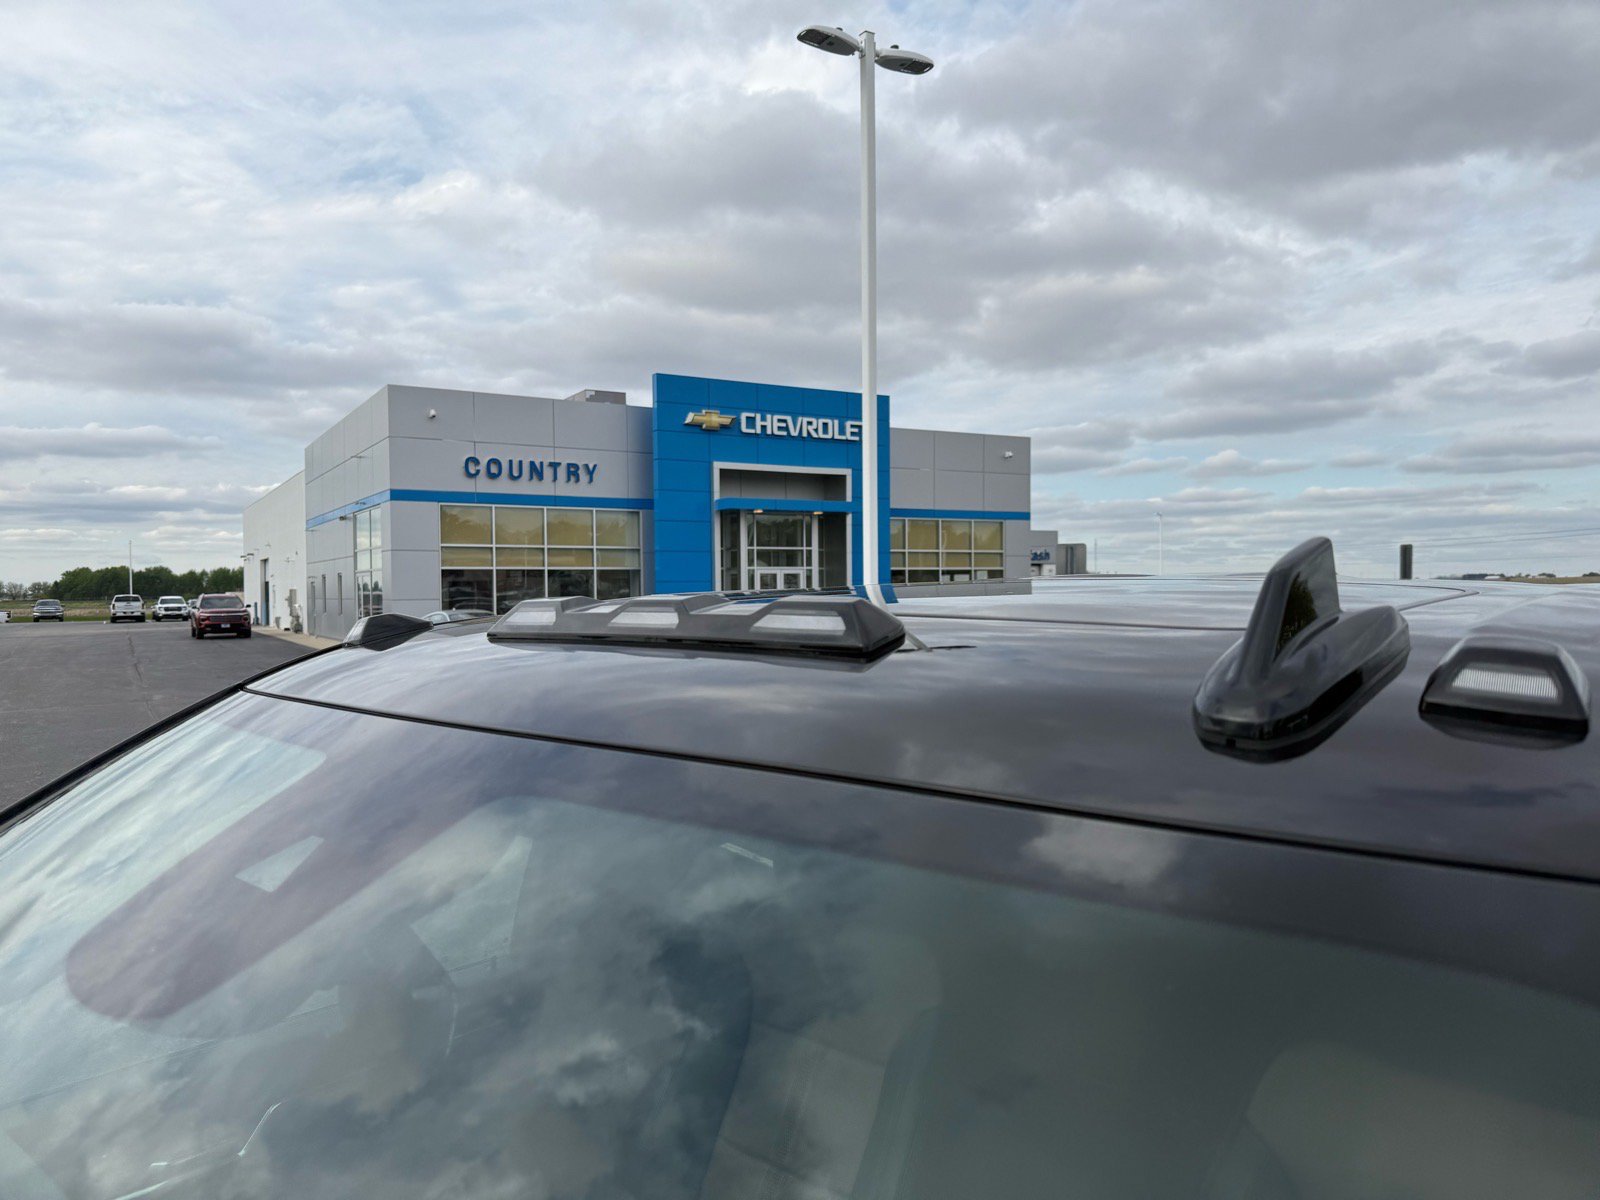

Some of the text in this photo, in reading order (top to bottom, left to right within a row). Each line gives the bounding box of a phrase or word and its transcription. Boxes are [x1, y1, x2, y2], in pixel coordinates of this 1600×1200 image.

[740, 412, 863, 441] CHEVROLE
[464, 456, 597, 484] COUNTRY
[1030, 549, 1050, 561] ash
